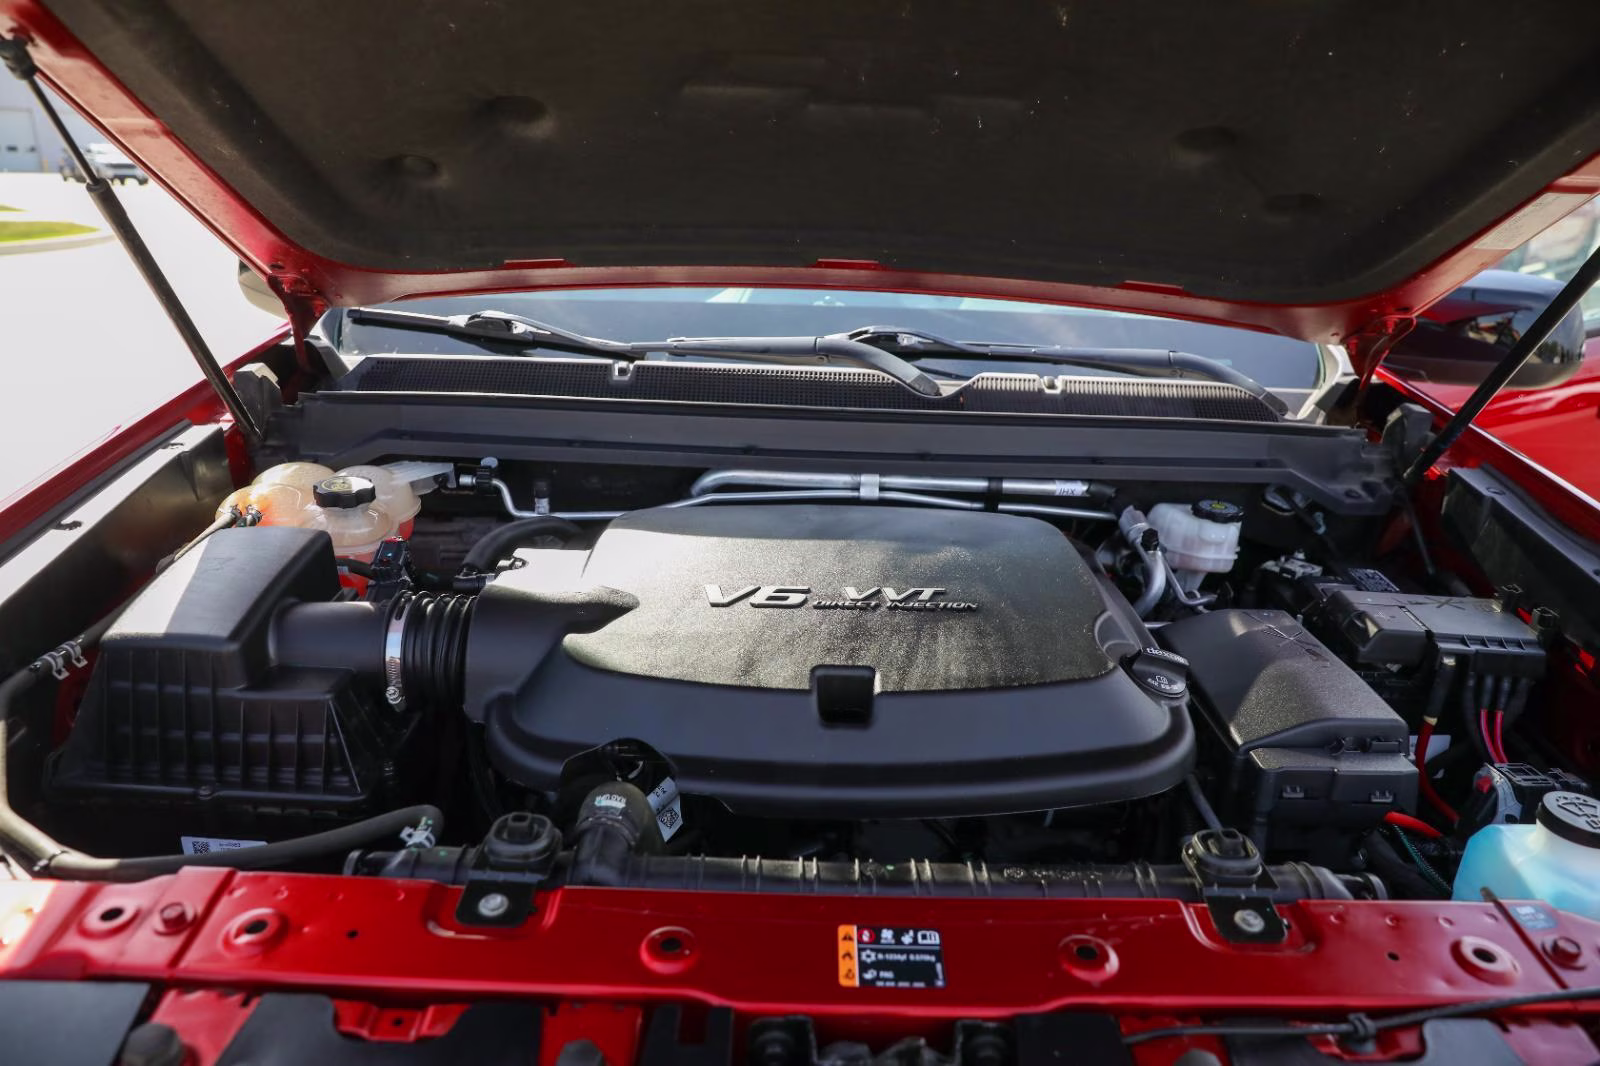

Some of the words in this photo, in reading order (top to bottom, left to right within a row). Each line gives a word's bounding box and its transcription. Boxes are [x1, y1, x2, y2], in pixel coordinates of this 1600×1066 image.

[703, 584, 811, 608] V6
[843, 586, 946, 602] VVT
[813, 600, 881, 610] DIRECT
[886, 600, 979, 611] INJECTION
